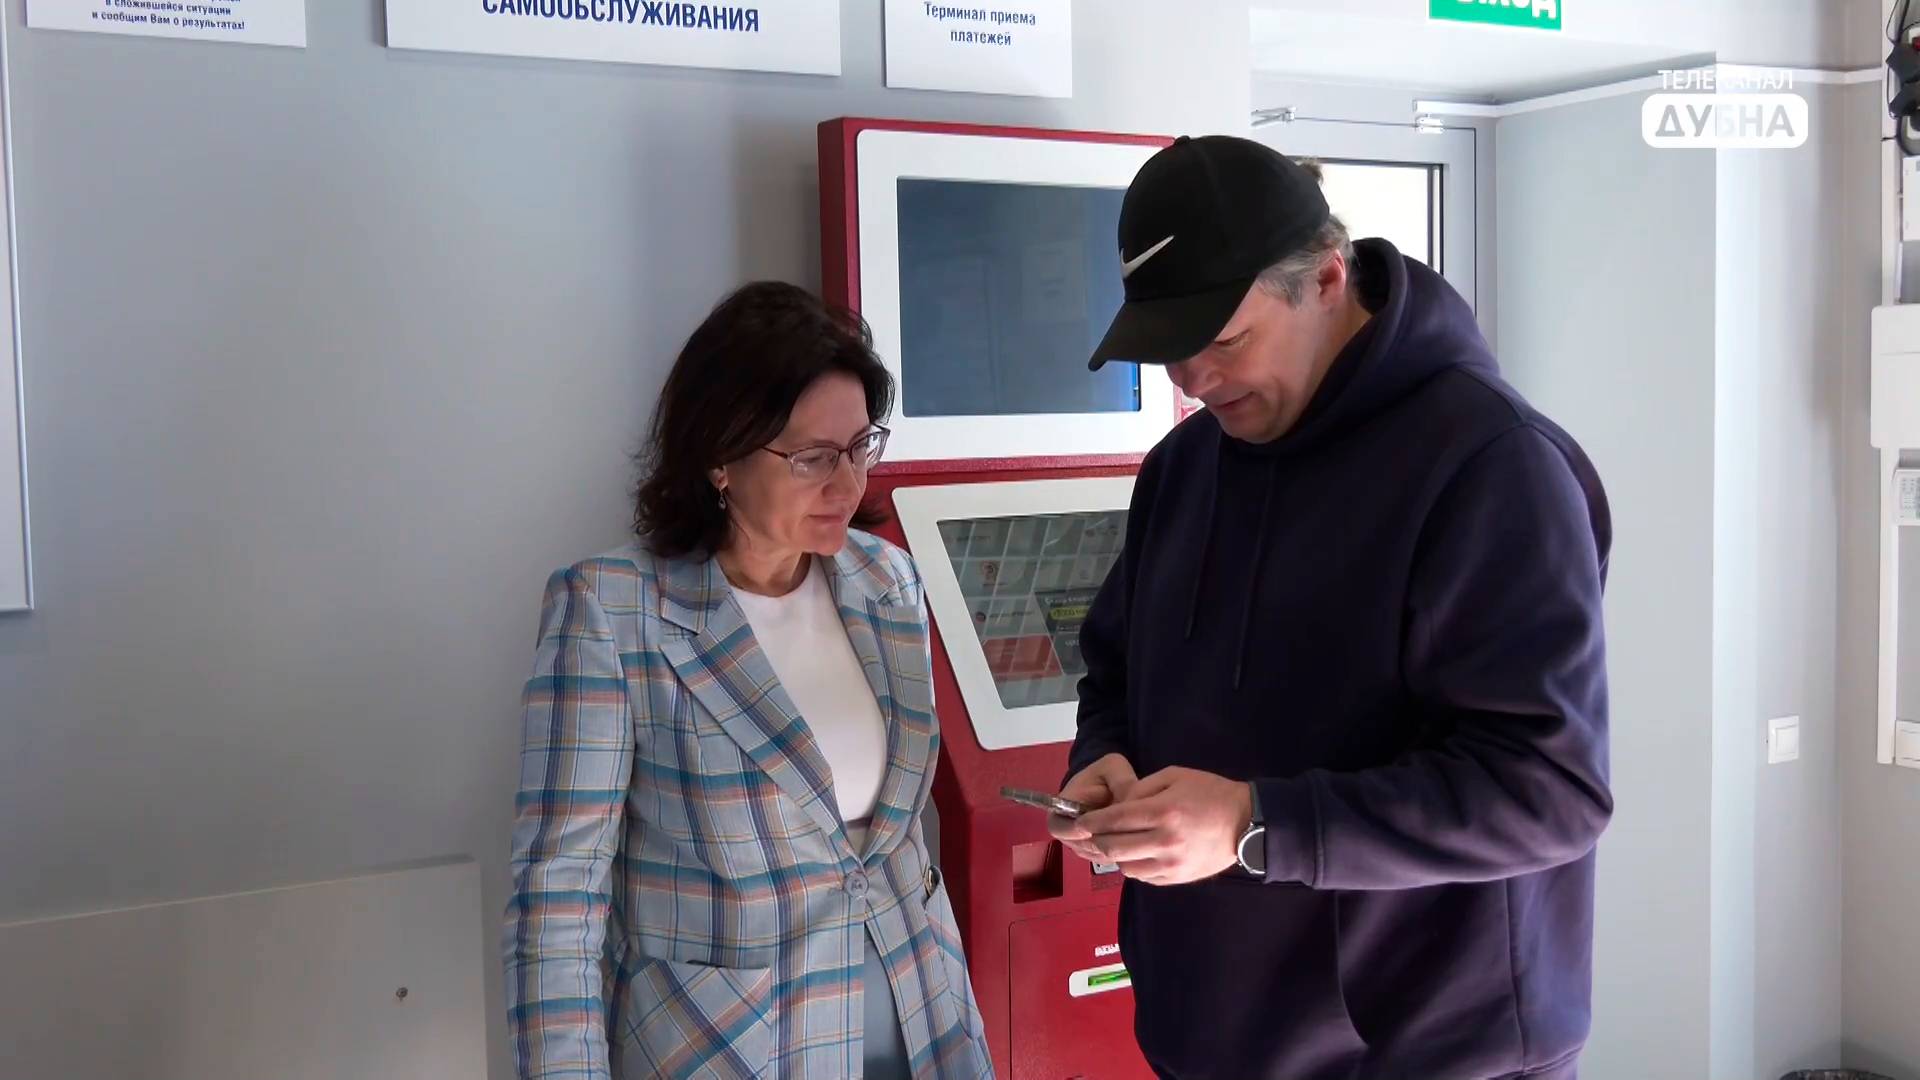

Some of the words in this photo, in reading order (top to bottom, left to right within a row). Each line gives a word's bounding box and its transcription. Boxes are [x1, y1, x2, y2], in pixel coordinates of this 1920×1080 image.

[186, 5, 231, 16] ситуации
[924, 1, 986, 21] Терминал
[990, 10, 1036, 26] приема
[91, 11, 99, 20] и
[101, 12, 148, 24] сообщим
[150, 13, 171, 24] Вам
[173, 17, 180, 26] о
[182, 18, 245, 30] результатах!
[950, 29, 1012, 46] платежей
